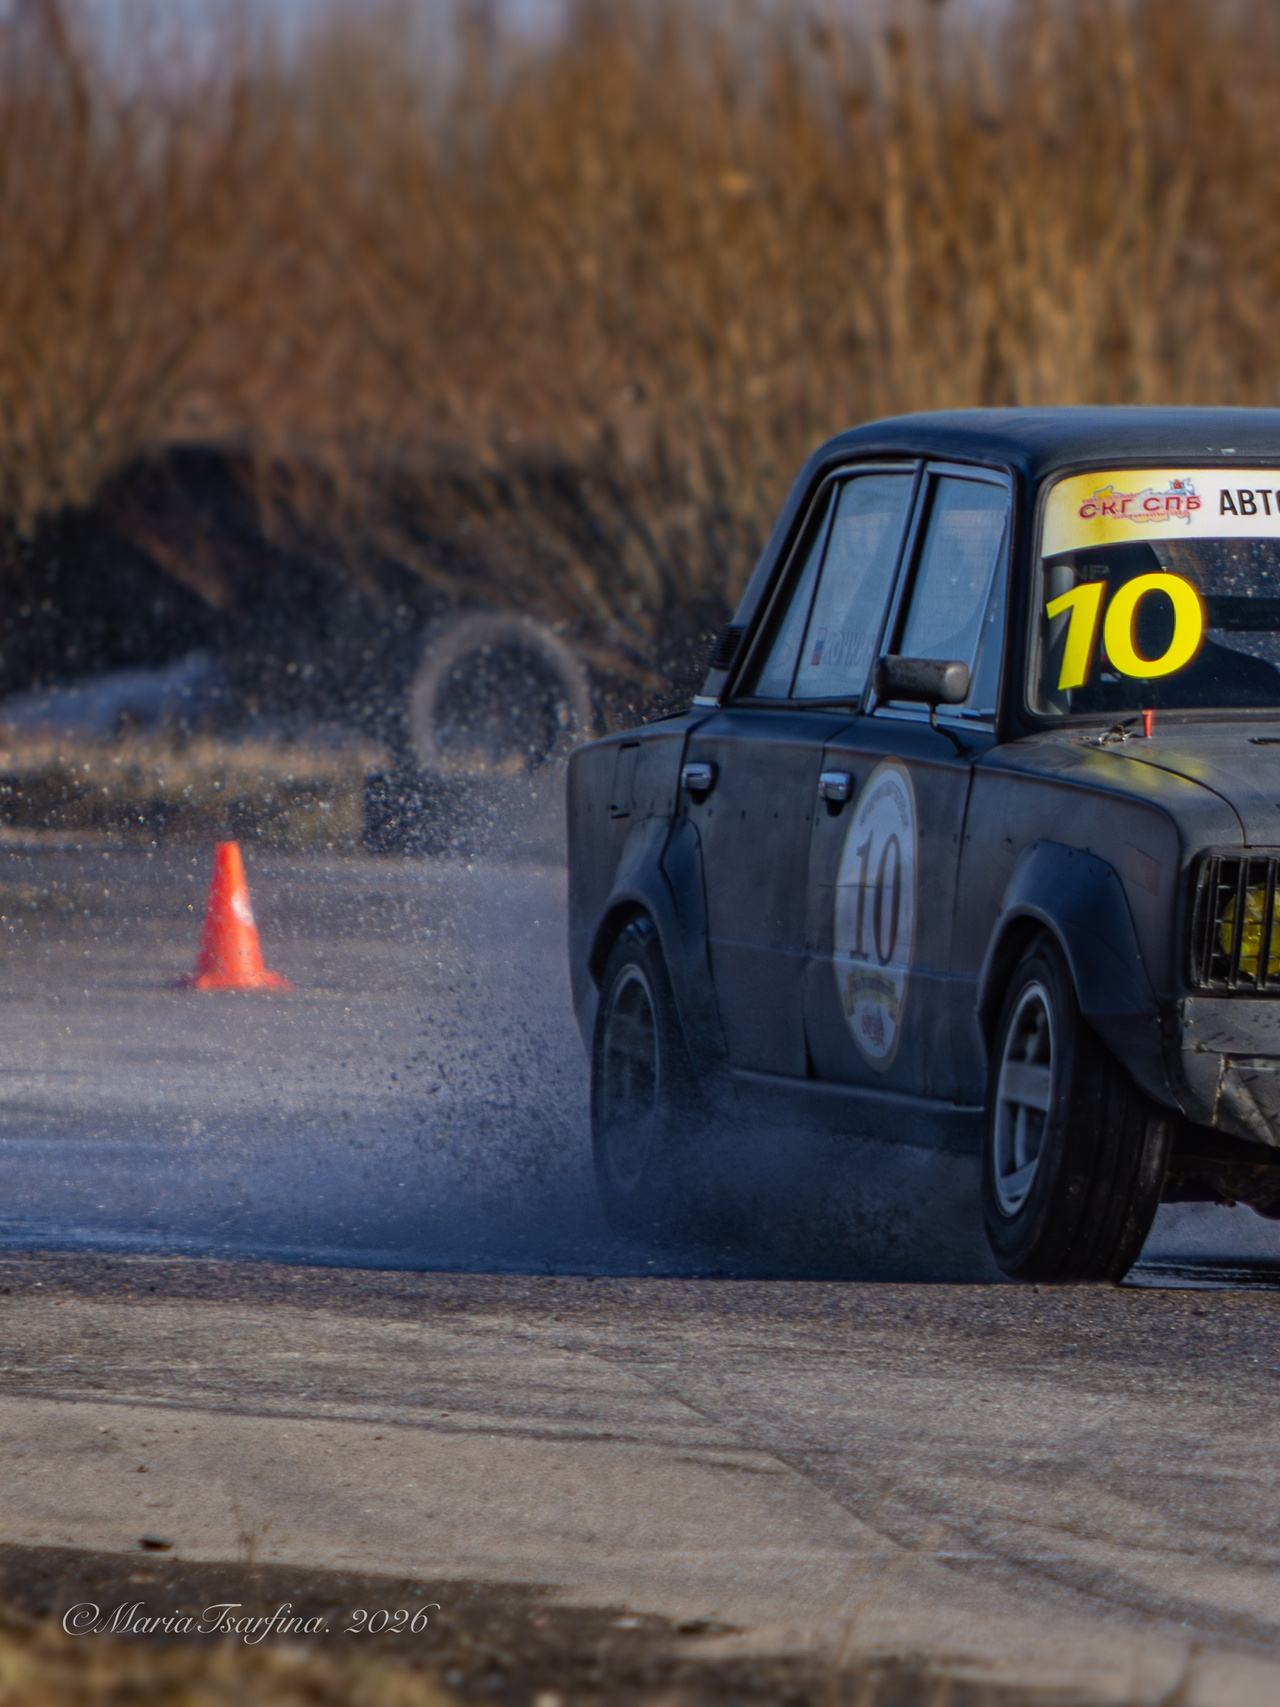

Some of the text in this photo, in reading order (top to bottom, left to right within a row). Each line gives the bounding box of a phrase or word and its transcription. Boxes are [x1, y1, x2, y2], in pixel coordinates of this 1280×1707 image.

[1078, 498, 1134, 519] СКГ
[1142, 495, 1202, 512] СПБ
[1046, 572, 1203, 691] 10
[850, 830, 901, 967] 10
